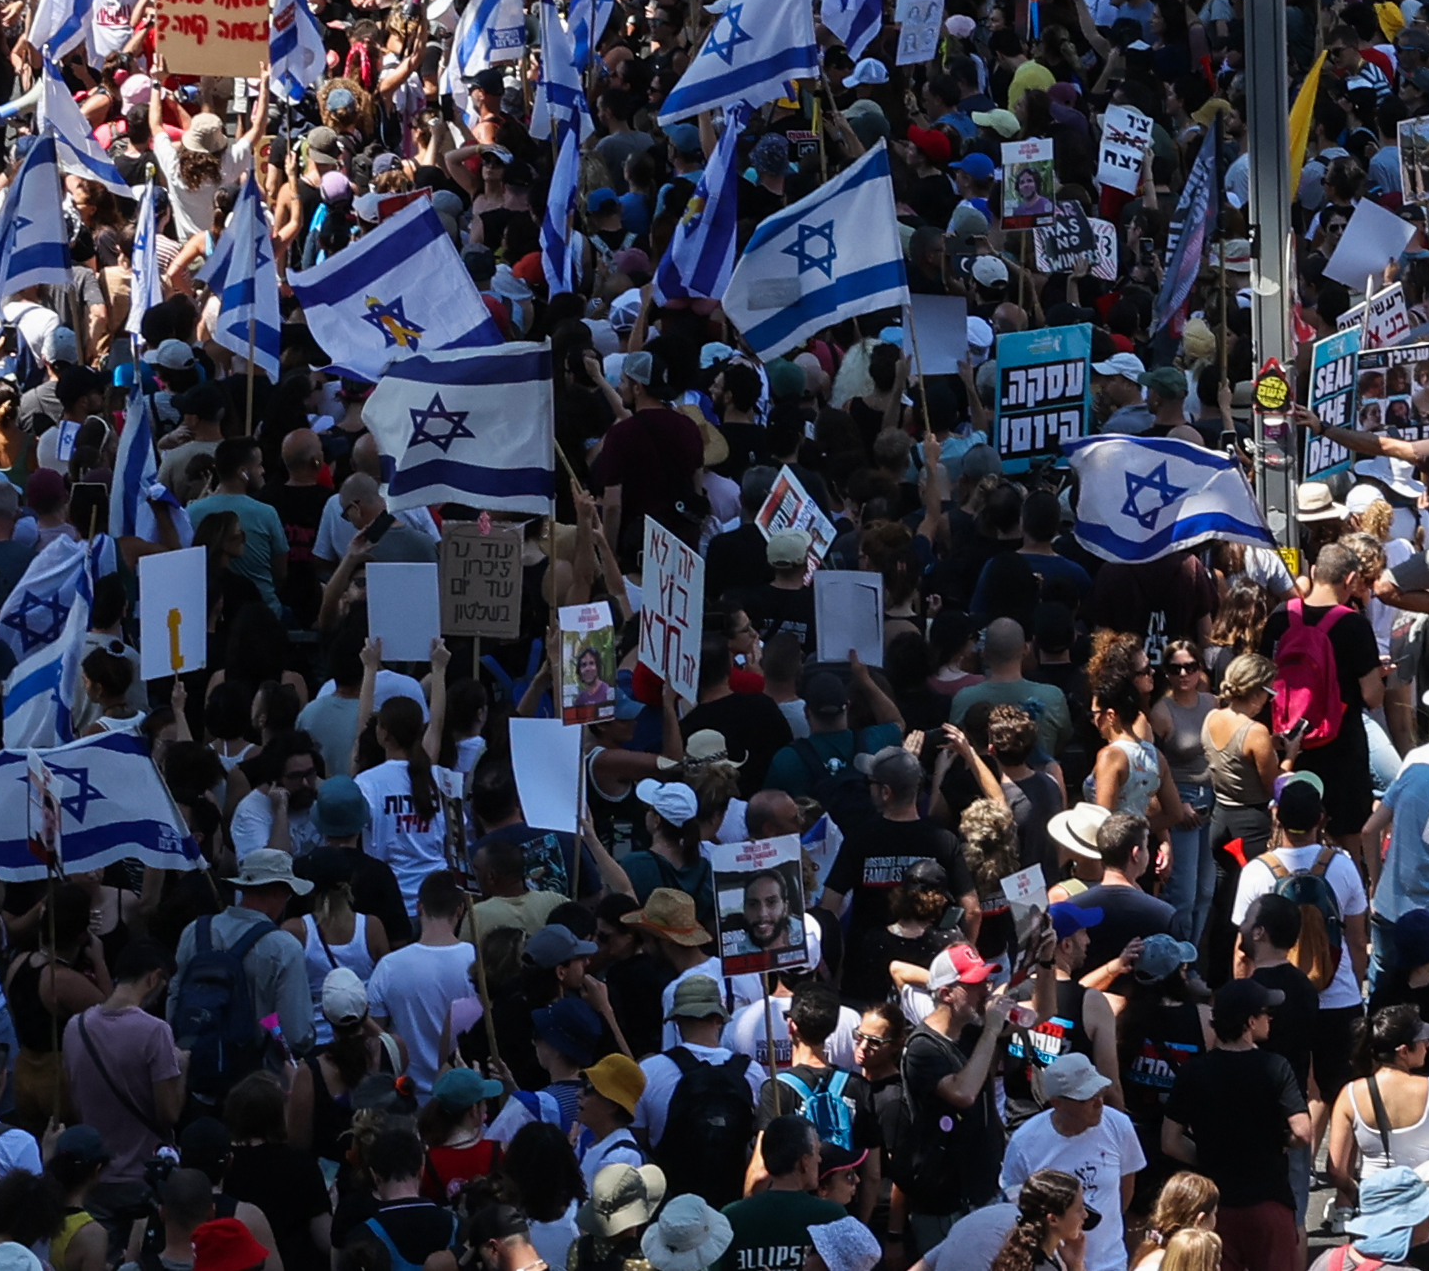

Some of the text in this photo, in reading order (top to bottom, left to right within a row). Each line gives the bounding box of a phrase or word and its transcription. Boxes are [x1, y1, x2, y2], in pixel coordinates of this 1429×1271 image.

[1055, 200, 1077, 217] AR
[1044, 218, 1081, 239] HAS
[1055, 235, 1080, 251] NO
[1001, 357, 1085, 409] עסקה.
[1314, 361, 1354, 398] SEAL
[1317, 396, 1346, 426] THE
[1000, 407, 1081, 458] היום!
[1308, 436, 1351, 475] DEAL
[650, 527, 669, 566] לא
